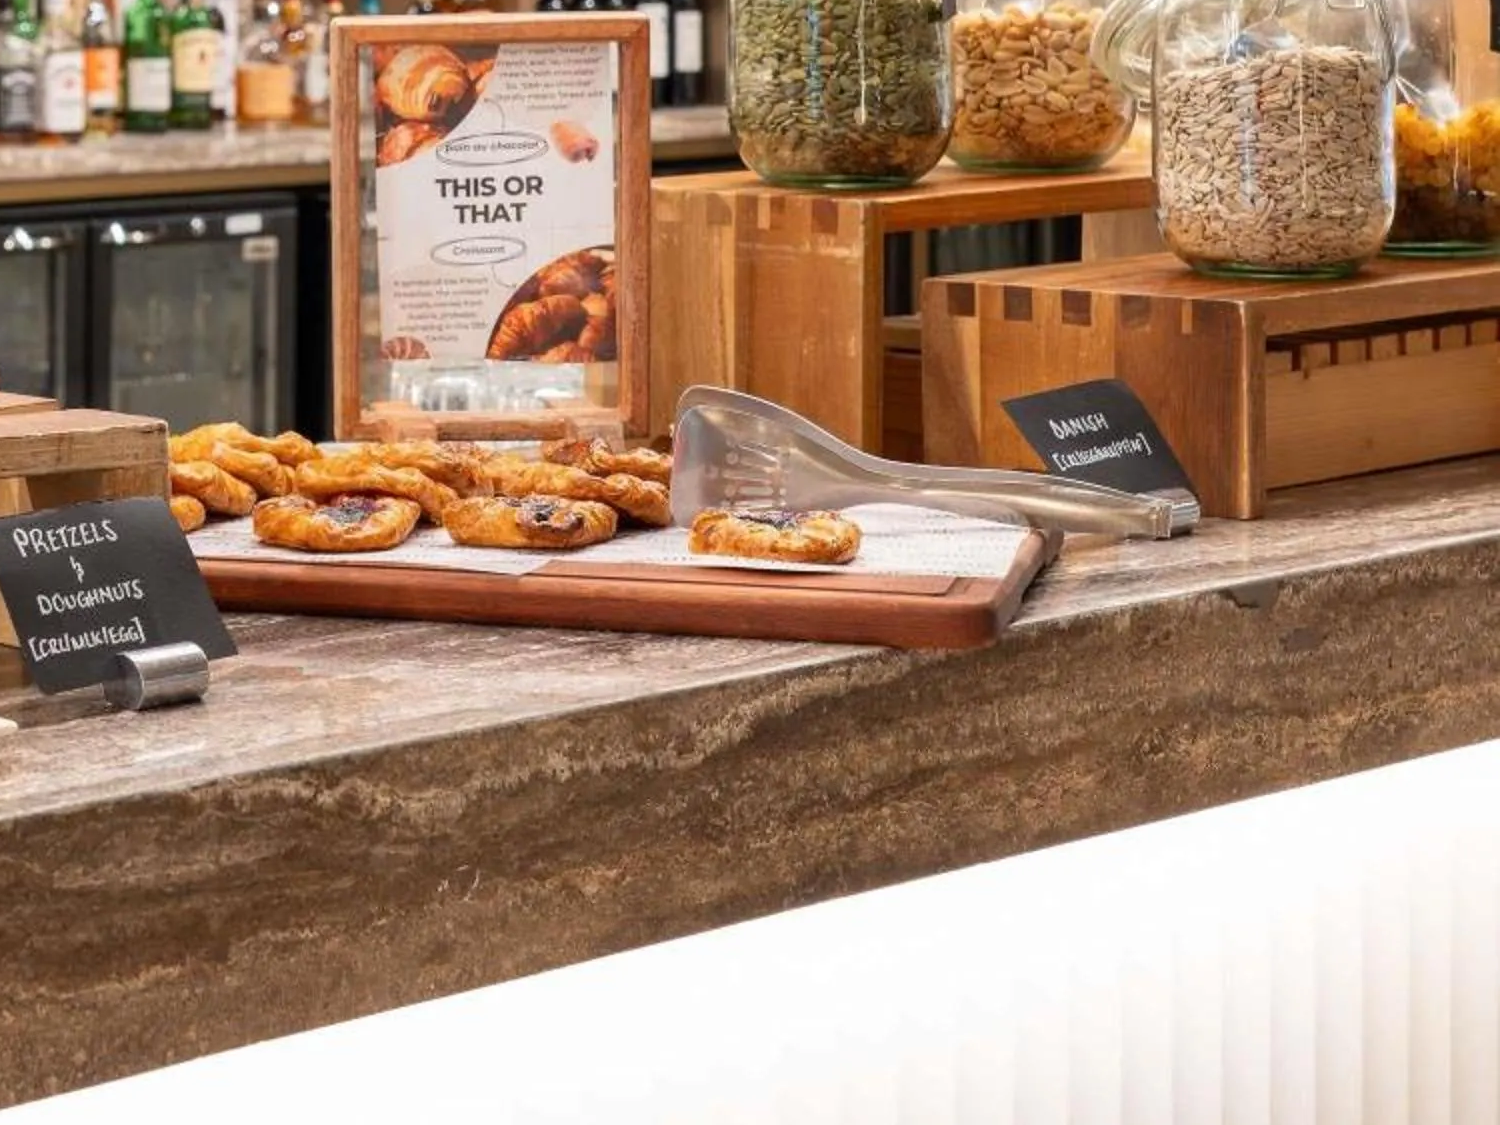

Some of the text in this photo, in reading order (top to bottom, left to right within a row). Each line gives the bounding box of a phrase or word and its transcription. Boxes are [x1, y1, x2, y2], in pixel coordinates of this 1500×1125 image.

[435, 175, 544, 198] THIS OR
[453, 202, 527, 225] THAT
[452, 245, 506, 257] Croissant
[1049, 412, 1110, 440] DANISH
[12, 519, 119, 558] PRETZELS
[36, 578, 145, 616] DOUGHNUTS
